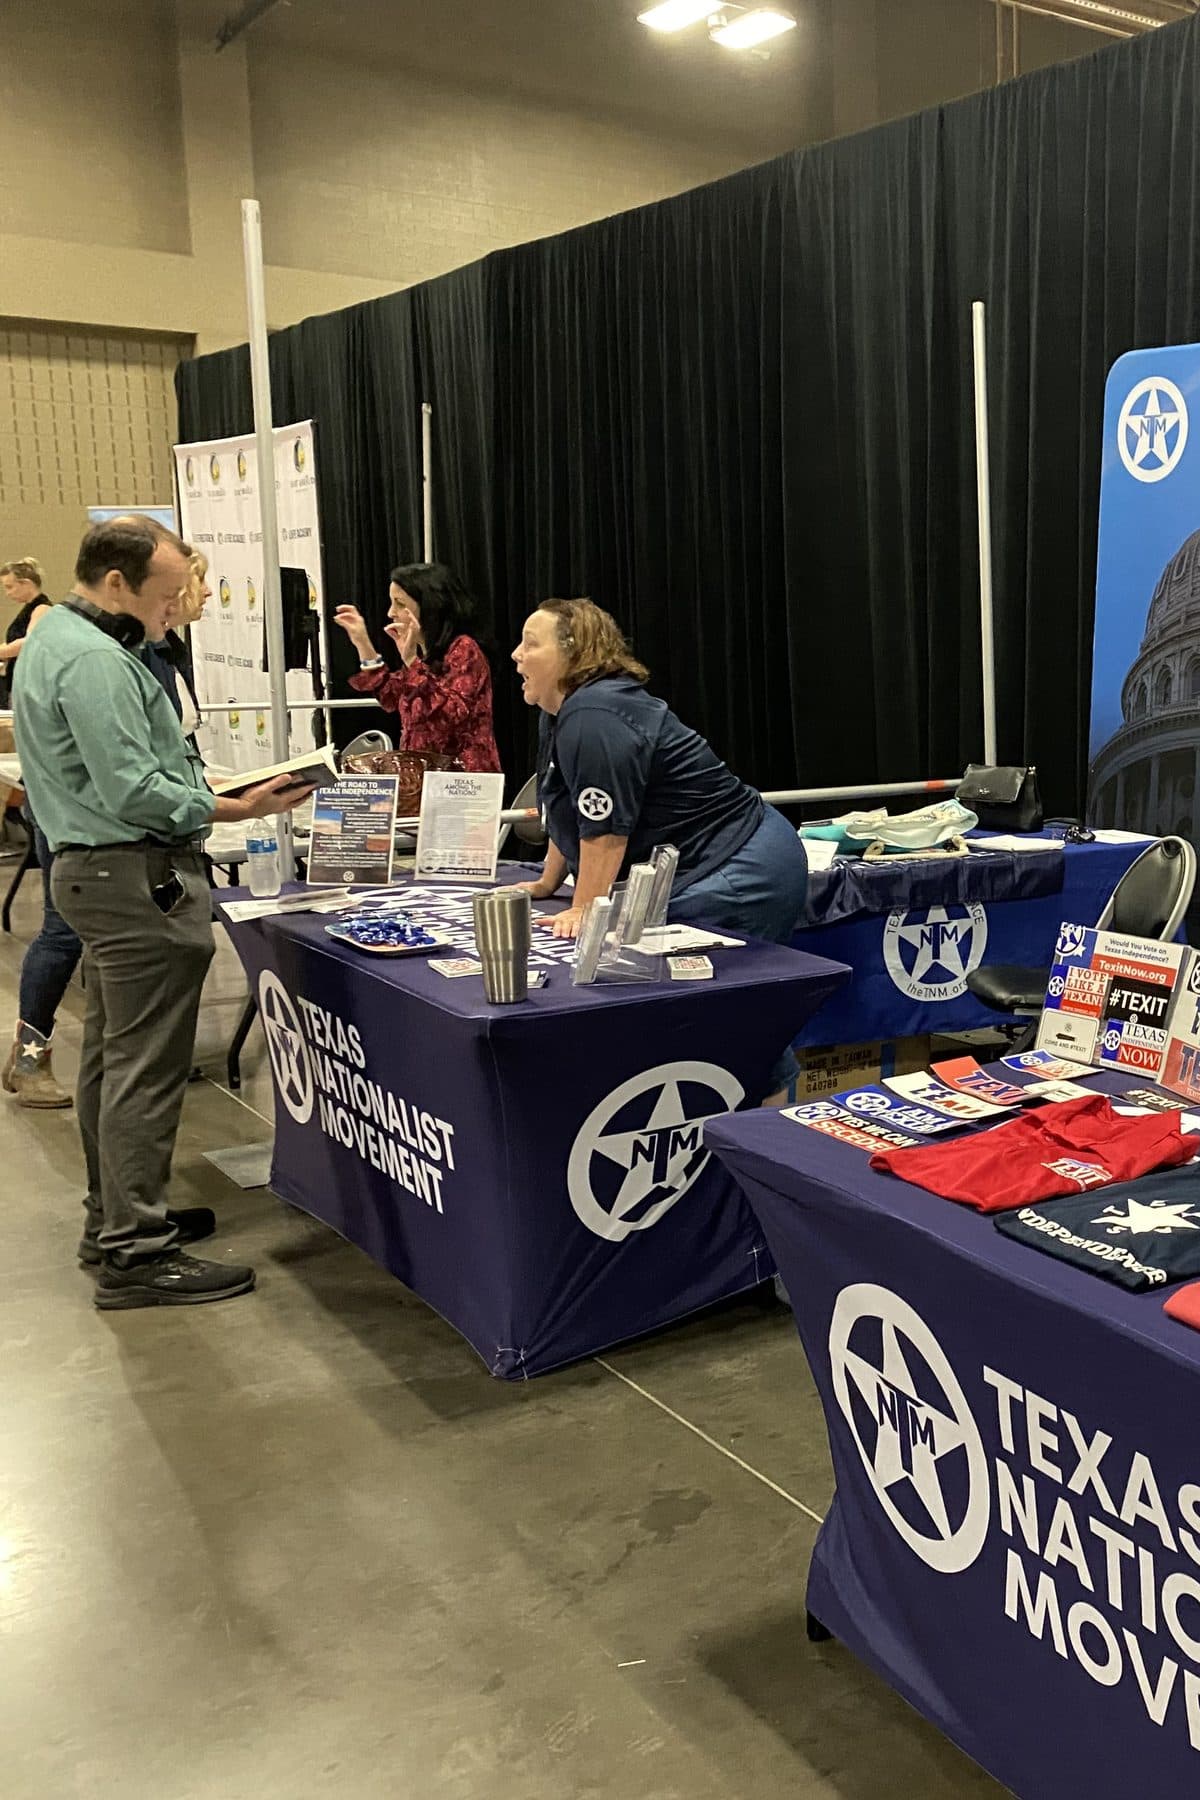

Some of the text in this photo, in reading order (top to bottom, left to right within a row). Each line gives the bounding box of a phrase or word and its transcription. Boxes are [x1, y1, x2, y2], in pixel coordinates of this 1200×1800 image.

[1069, 968, 1106, 982] I VOTE
[1099, 959, 1167, 983] TexitNow.org
[1067, 978, 1106, 994] LIKE A
[1110, 988, 1168, 1017] #TEXIT
[297, 995, 366, 1069] TEXAS
[1125, 1023, 1166, 1042] TEXAS
[1119, 1046, 1161, 1070] NOW!
[307, 1045, 455, 1171] NATIONALIST
[863, 1124, 892, 1137] WE
[318, 1093, 443, 1214] MOVEMENT
[1045, 1159, 1112, 1185] TEXIT
